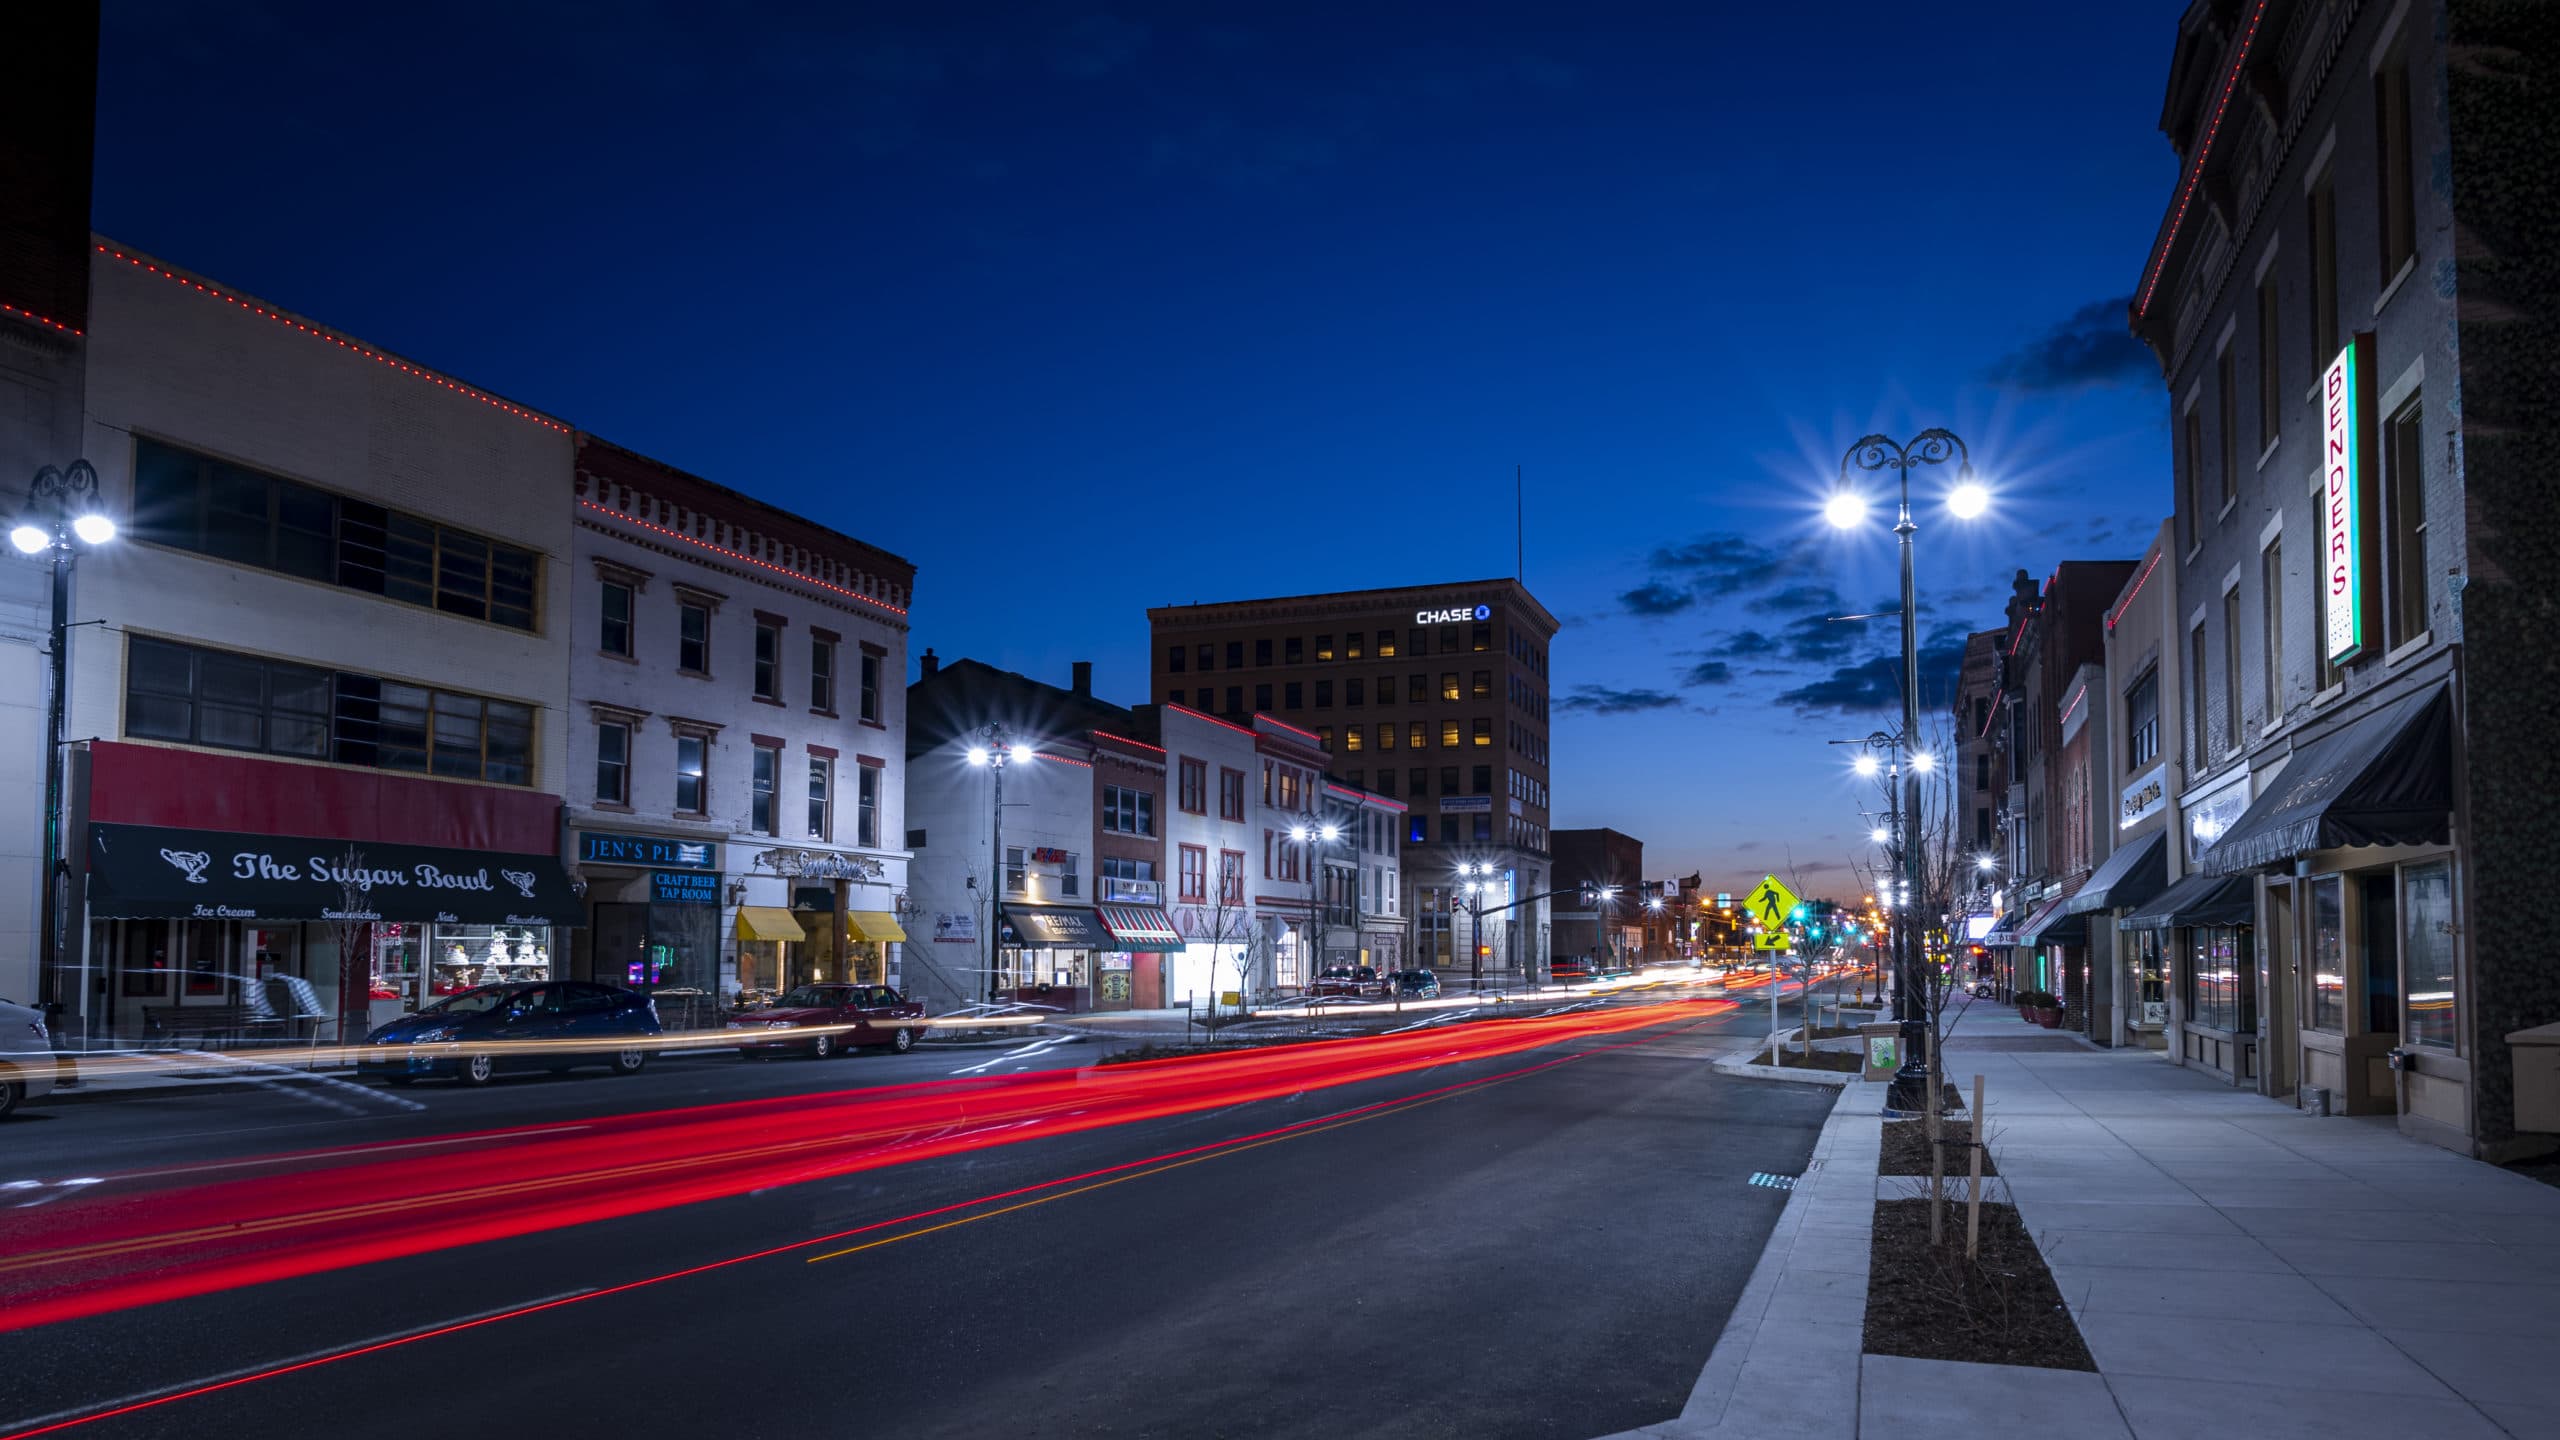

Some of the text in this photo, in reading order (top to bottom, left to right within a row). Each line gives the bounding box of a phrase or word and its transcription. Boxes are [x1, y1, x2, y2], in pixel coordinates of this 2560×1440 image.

[2328, 365, 2346, 595] BENDERS
[1416, 607, 1473, 624] CHASE
[588, 839, 709, 864] JEN'S PLAE
[233, 852, 494, 891] The Sugar Bowl
[656, 873, 716, 888] CRAFT BEER
[660, 886, 712, 900] TAP ROOM
[192, 904, 257, 918] Ice Cream
[434, 911, 459, 922] Nuts
[1044, 914, 1085, 928] RE/MAX
